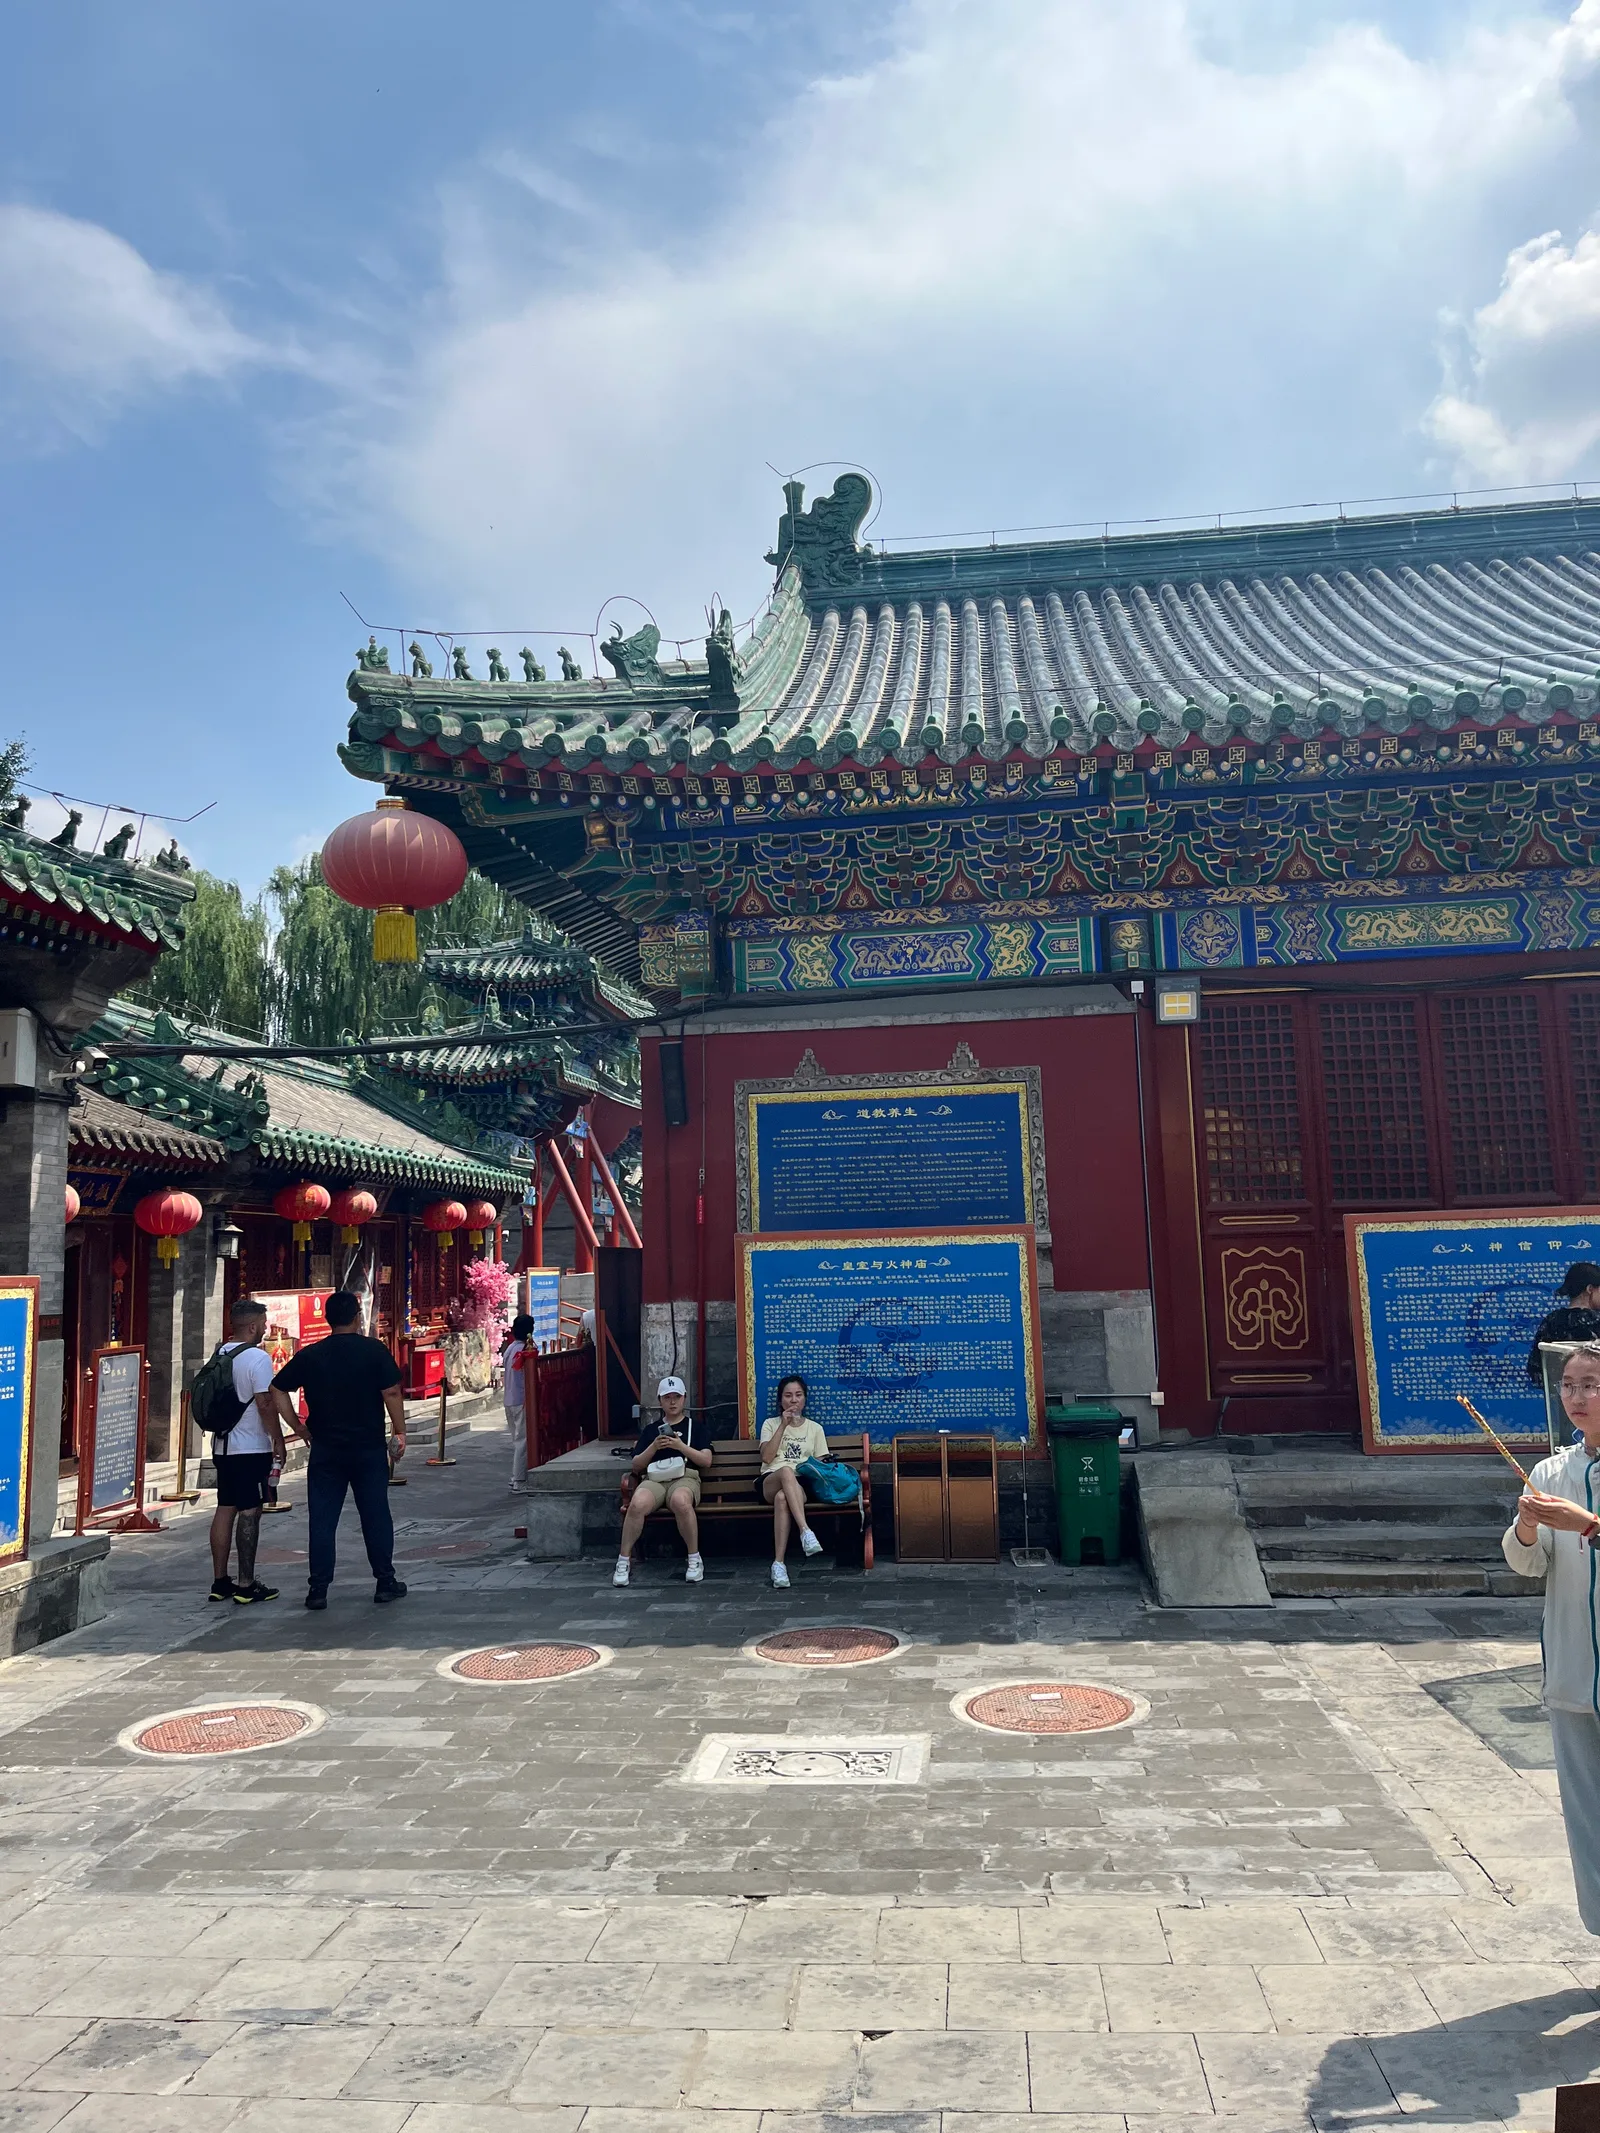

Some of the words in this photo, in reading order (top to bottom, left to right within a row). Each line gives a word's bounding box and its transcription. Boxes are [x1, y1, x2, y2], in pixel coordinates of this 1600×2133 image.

[856, 1107, 918, 1119] 道教养生
[1459, 1240, 1562, 1253] 火神信仰
[841, 1259, 928, 1271] 皇室与火神庙
